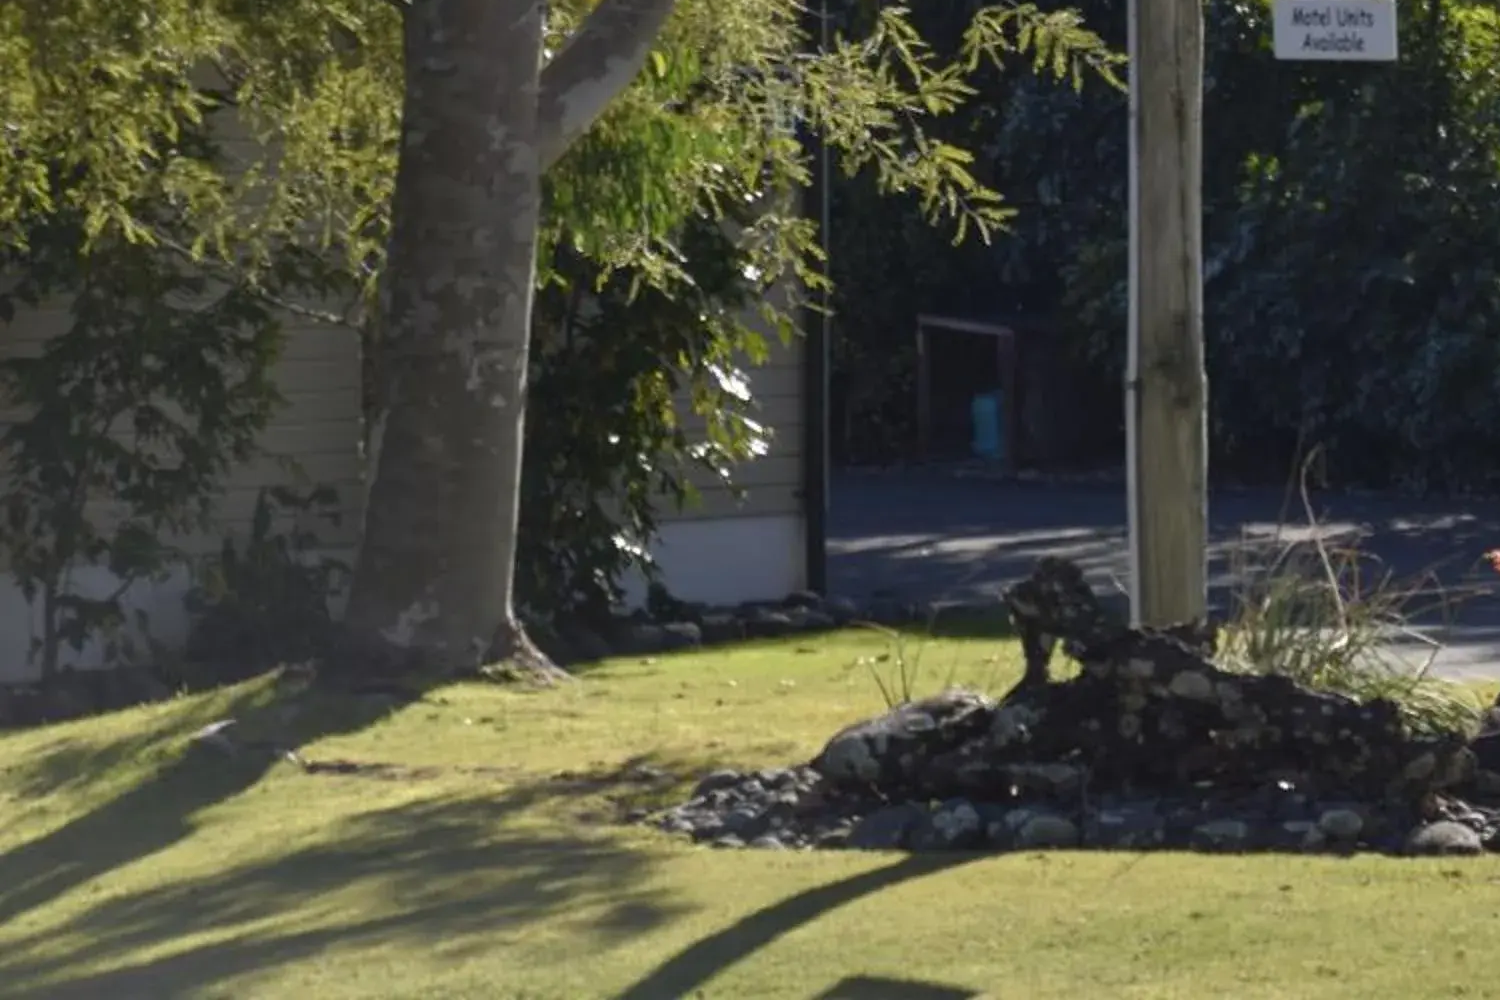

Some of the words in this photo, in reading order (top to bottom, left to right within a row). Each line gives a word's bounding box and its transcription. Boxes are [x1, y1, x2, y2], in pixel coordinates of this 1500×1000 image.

[1292, 6, 1331, 27] Motel
[1336, 6, 1375, 28] Units
[1302, 32, 1366, 52] Available
